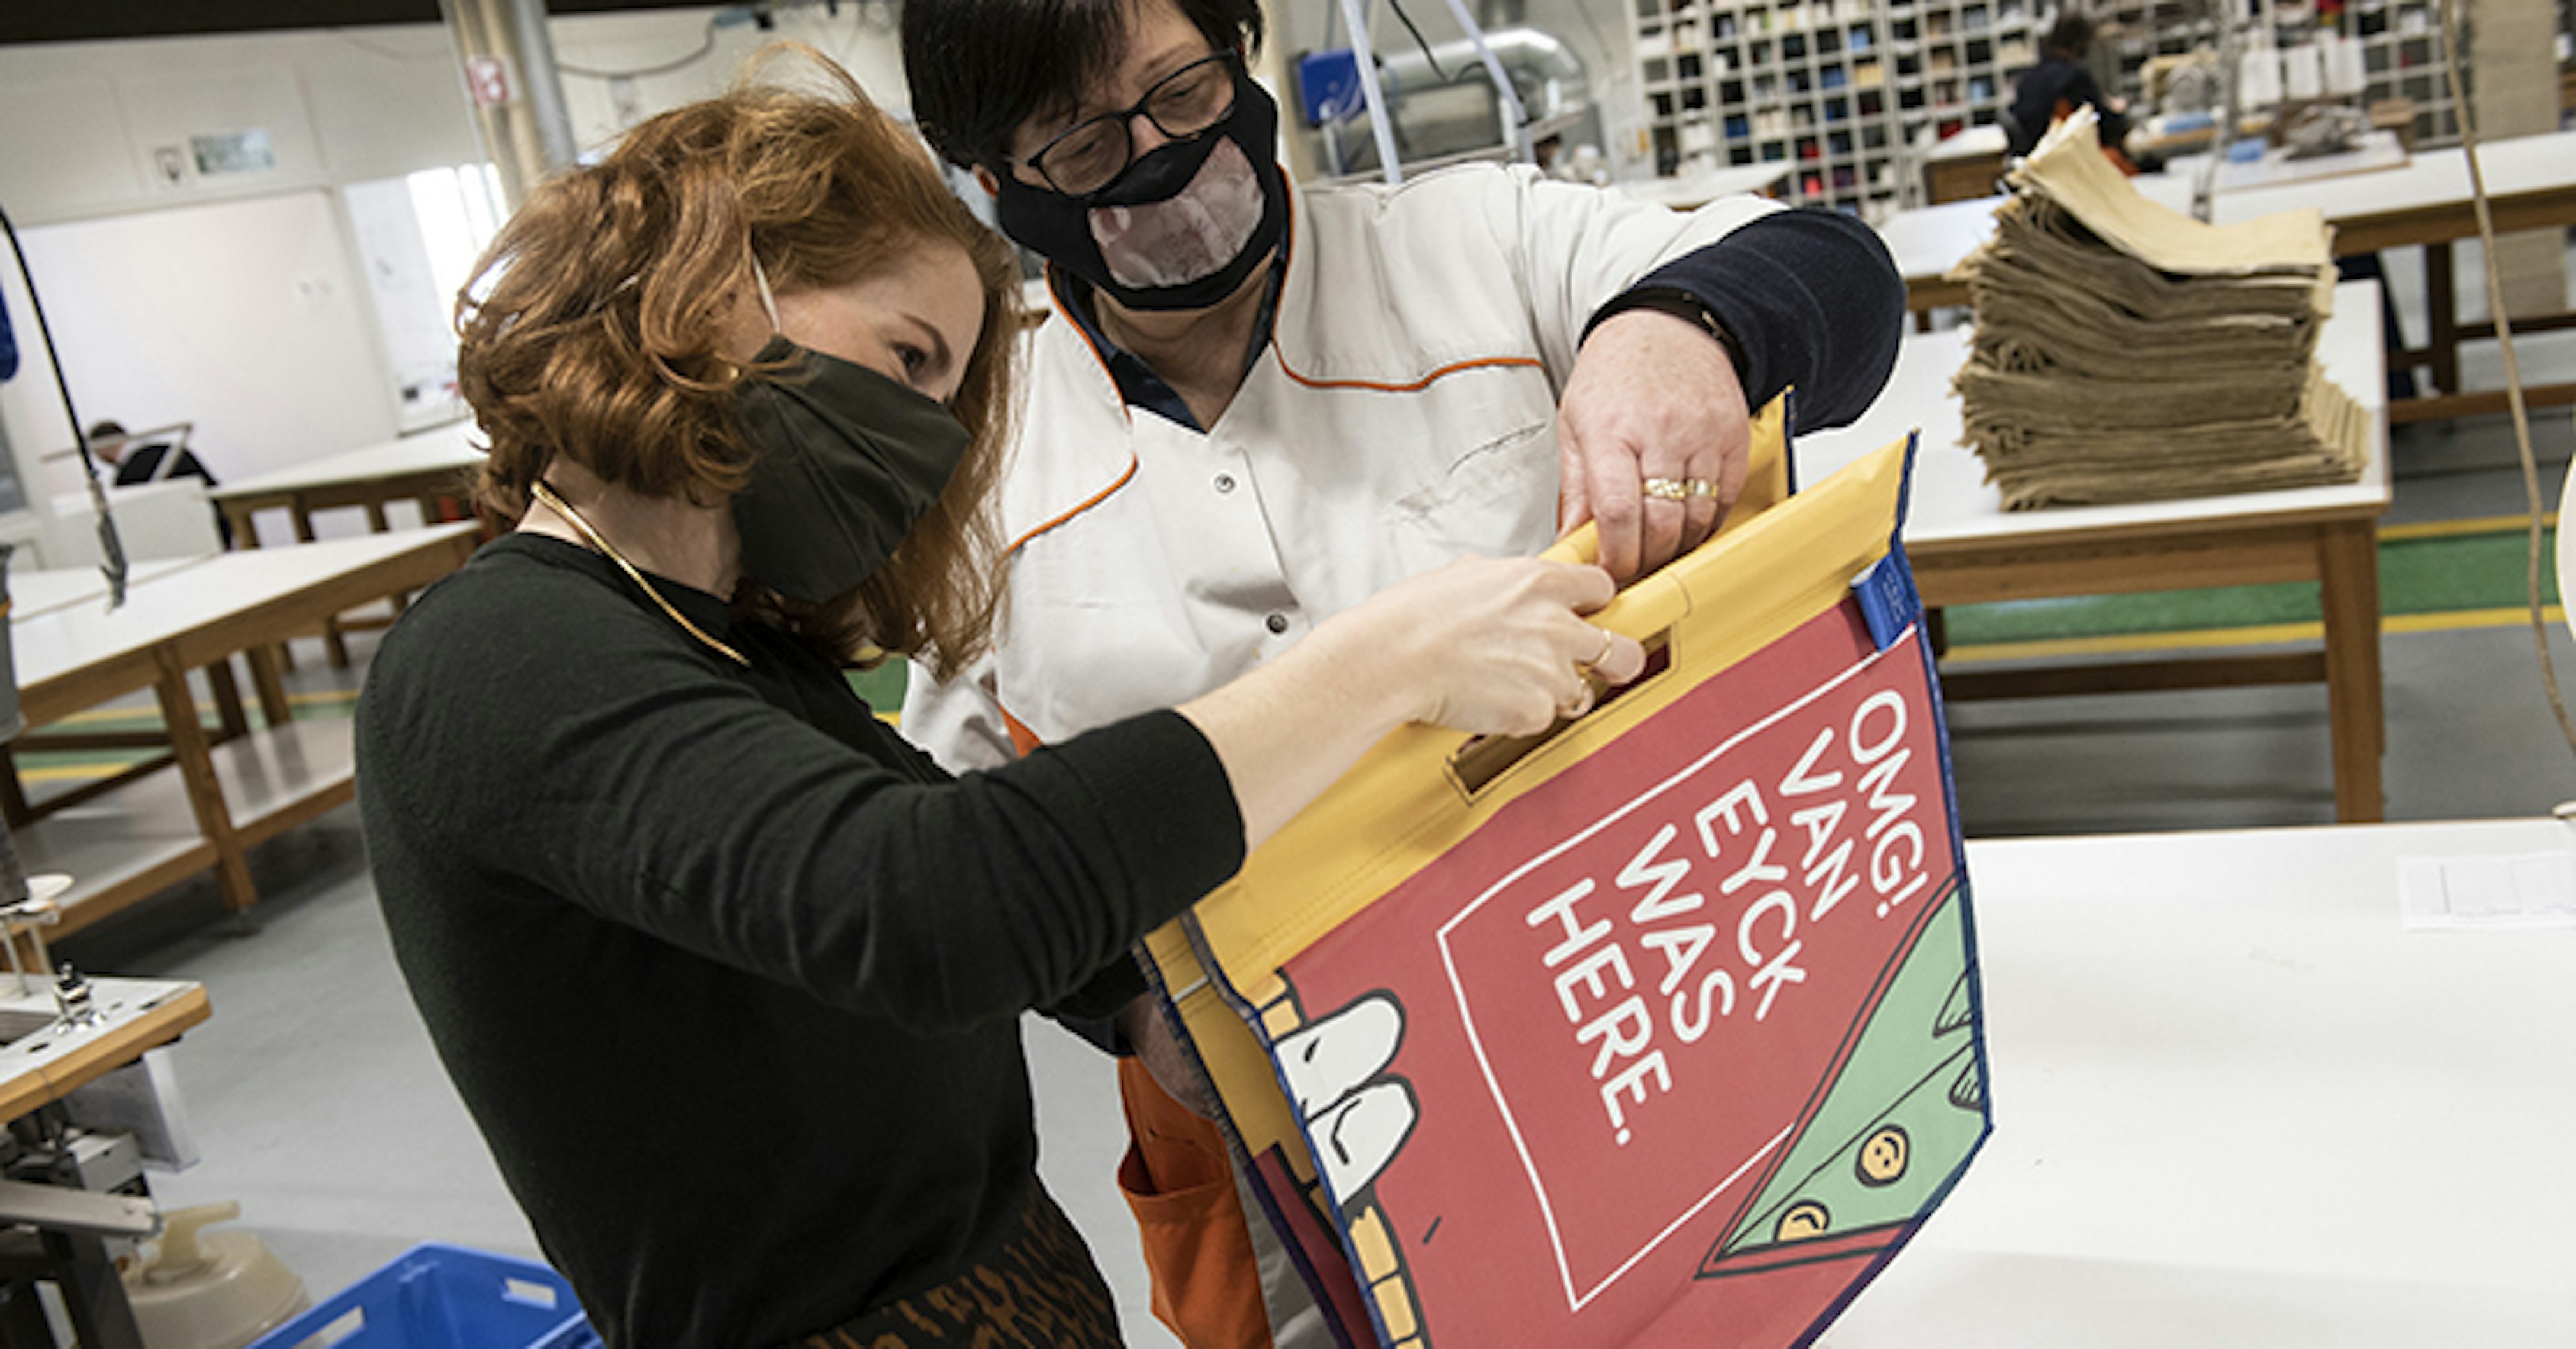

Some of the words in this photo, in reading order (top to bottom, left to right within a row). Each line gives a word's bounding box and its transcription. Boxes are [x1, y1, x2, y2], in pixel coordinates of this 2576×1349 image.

[1694, 778, 1807, 1022] EYCK
[1778, 727, 1860, 922] VAN
[1848, 689, 1929, 919] OMG!
[1525, 877, 1672, 1146] HERE.
[1614, 822, 1735, 1044] WAS
